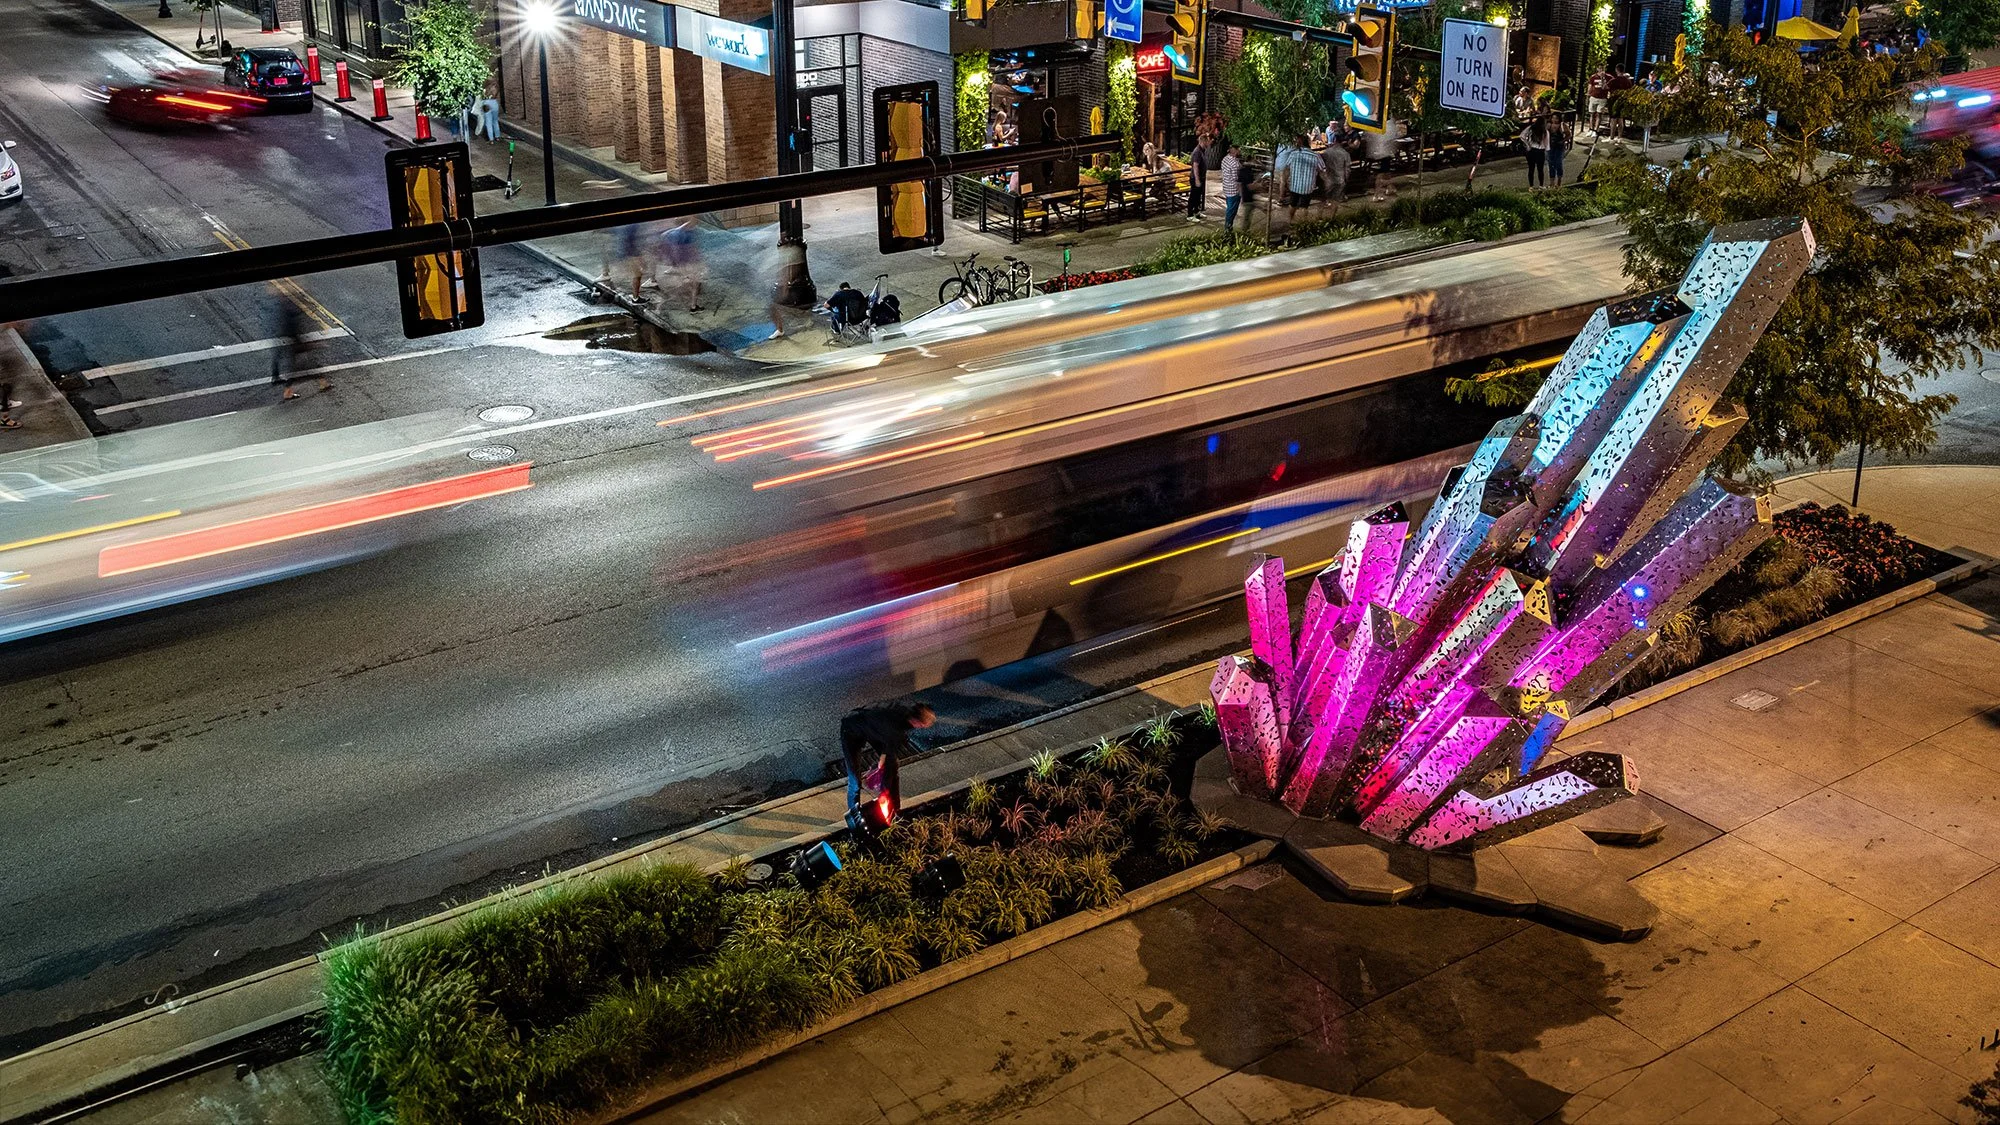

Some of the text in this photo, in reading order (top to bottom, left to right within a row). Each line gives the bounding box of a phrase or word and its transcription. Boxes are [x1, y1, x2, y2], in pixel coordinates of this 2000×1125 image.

[1510, 18, 1527, 27] 792
[1463, 34, 1487, 52] NO
[1456, 57, 1492, 78] TURN
[1446, 80, 1499, 103] ON RED
